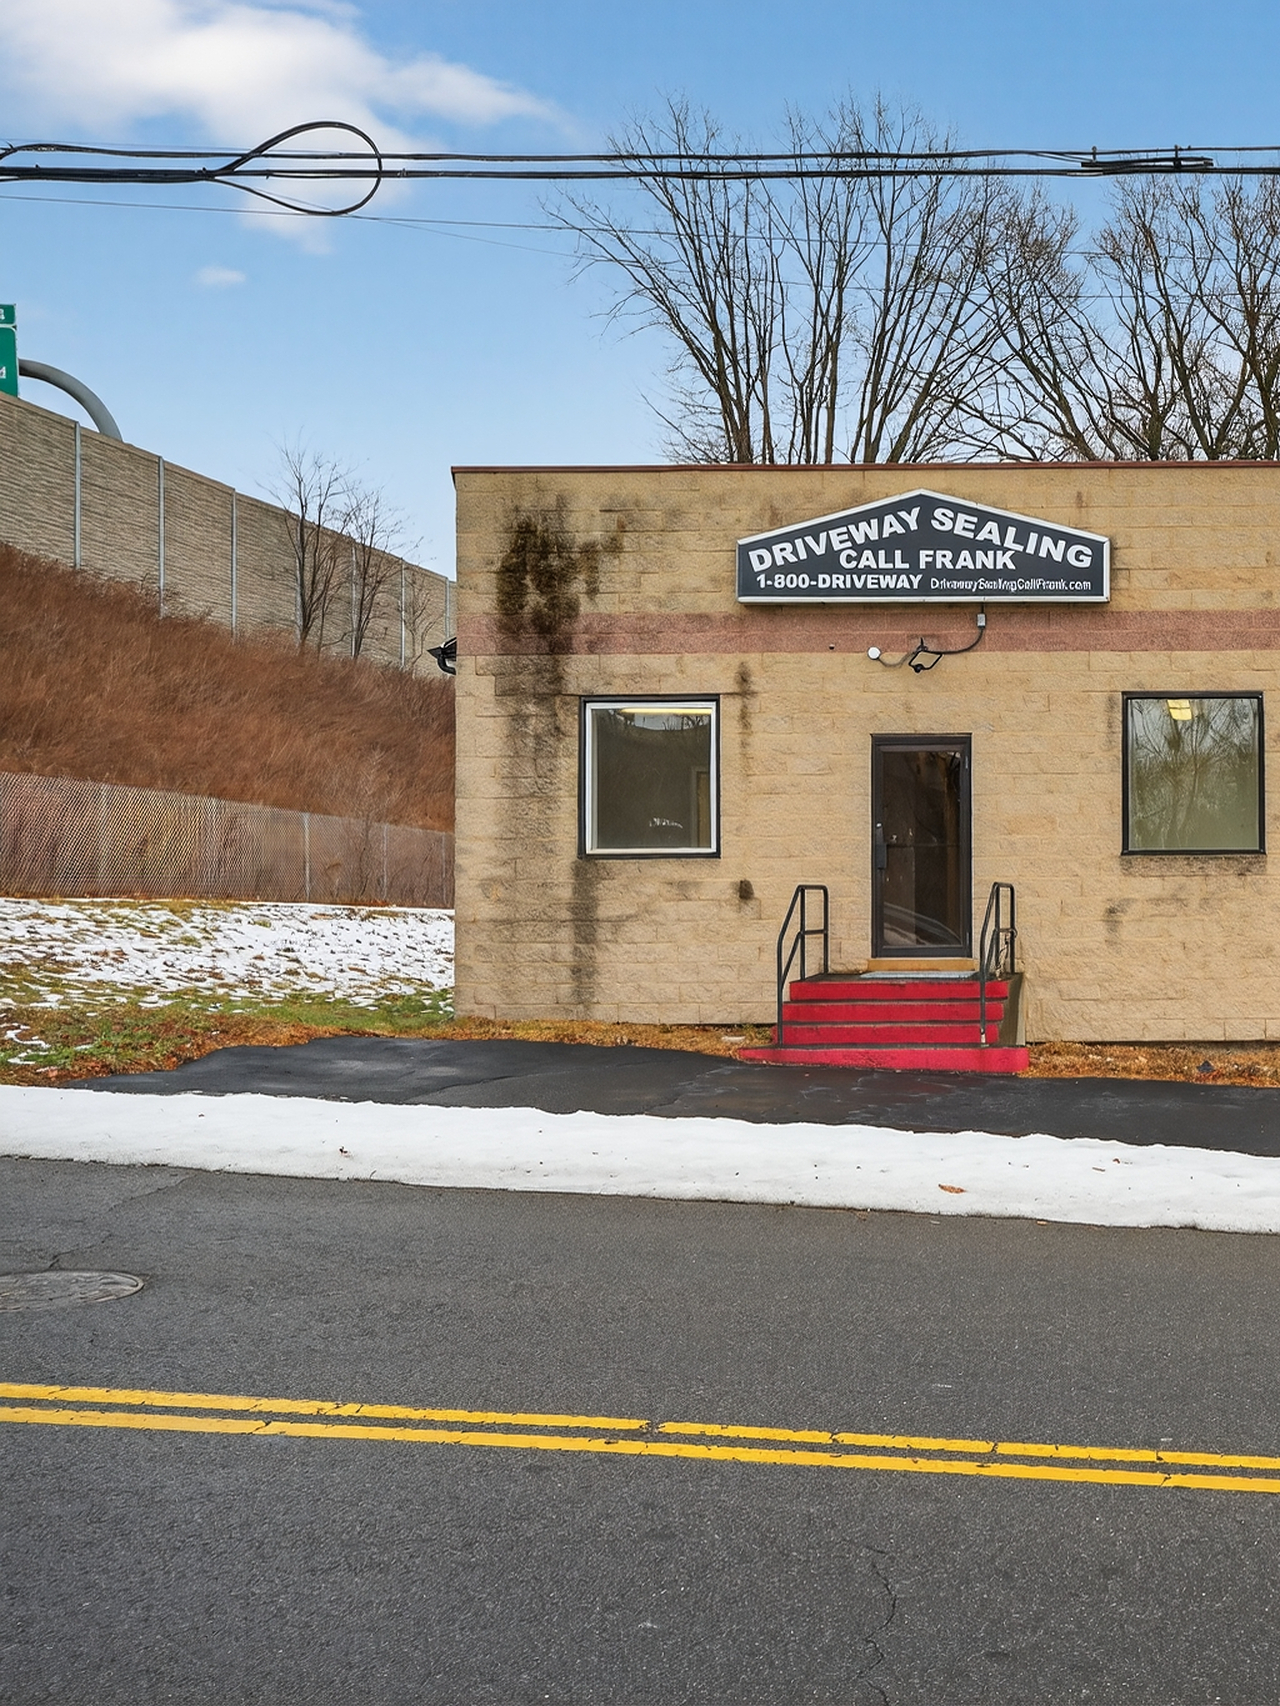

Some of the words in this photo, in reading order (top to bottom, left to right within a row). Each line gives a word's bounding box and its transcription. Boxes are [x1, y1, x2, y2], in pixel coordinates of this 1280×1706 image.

[748, 507, 921, 573] DRIVEWAY
[930, 507, 1093, 569] SEALING
[839, 549, 910, 570] CALL
[919, 549, 1016, 570] FRANK
[756, 574, 923, 590] 1-800-DRIVEWAY
